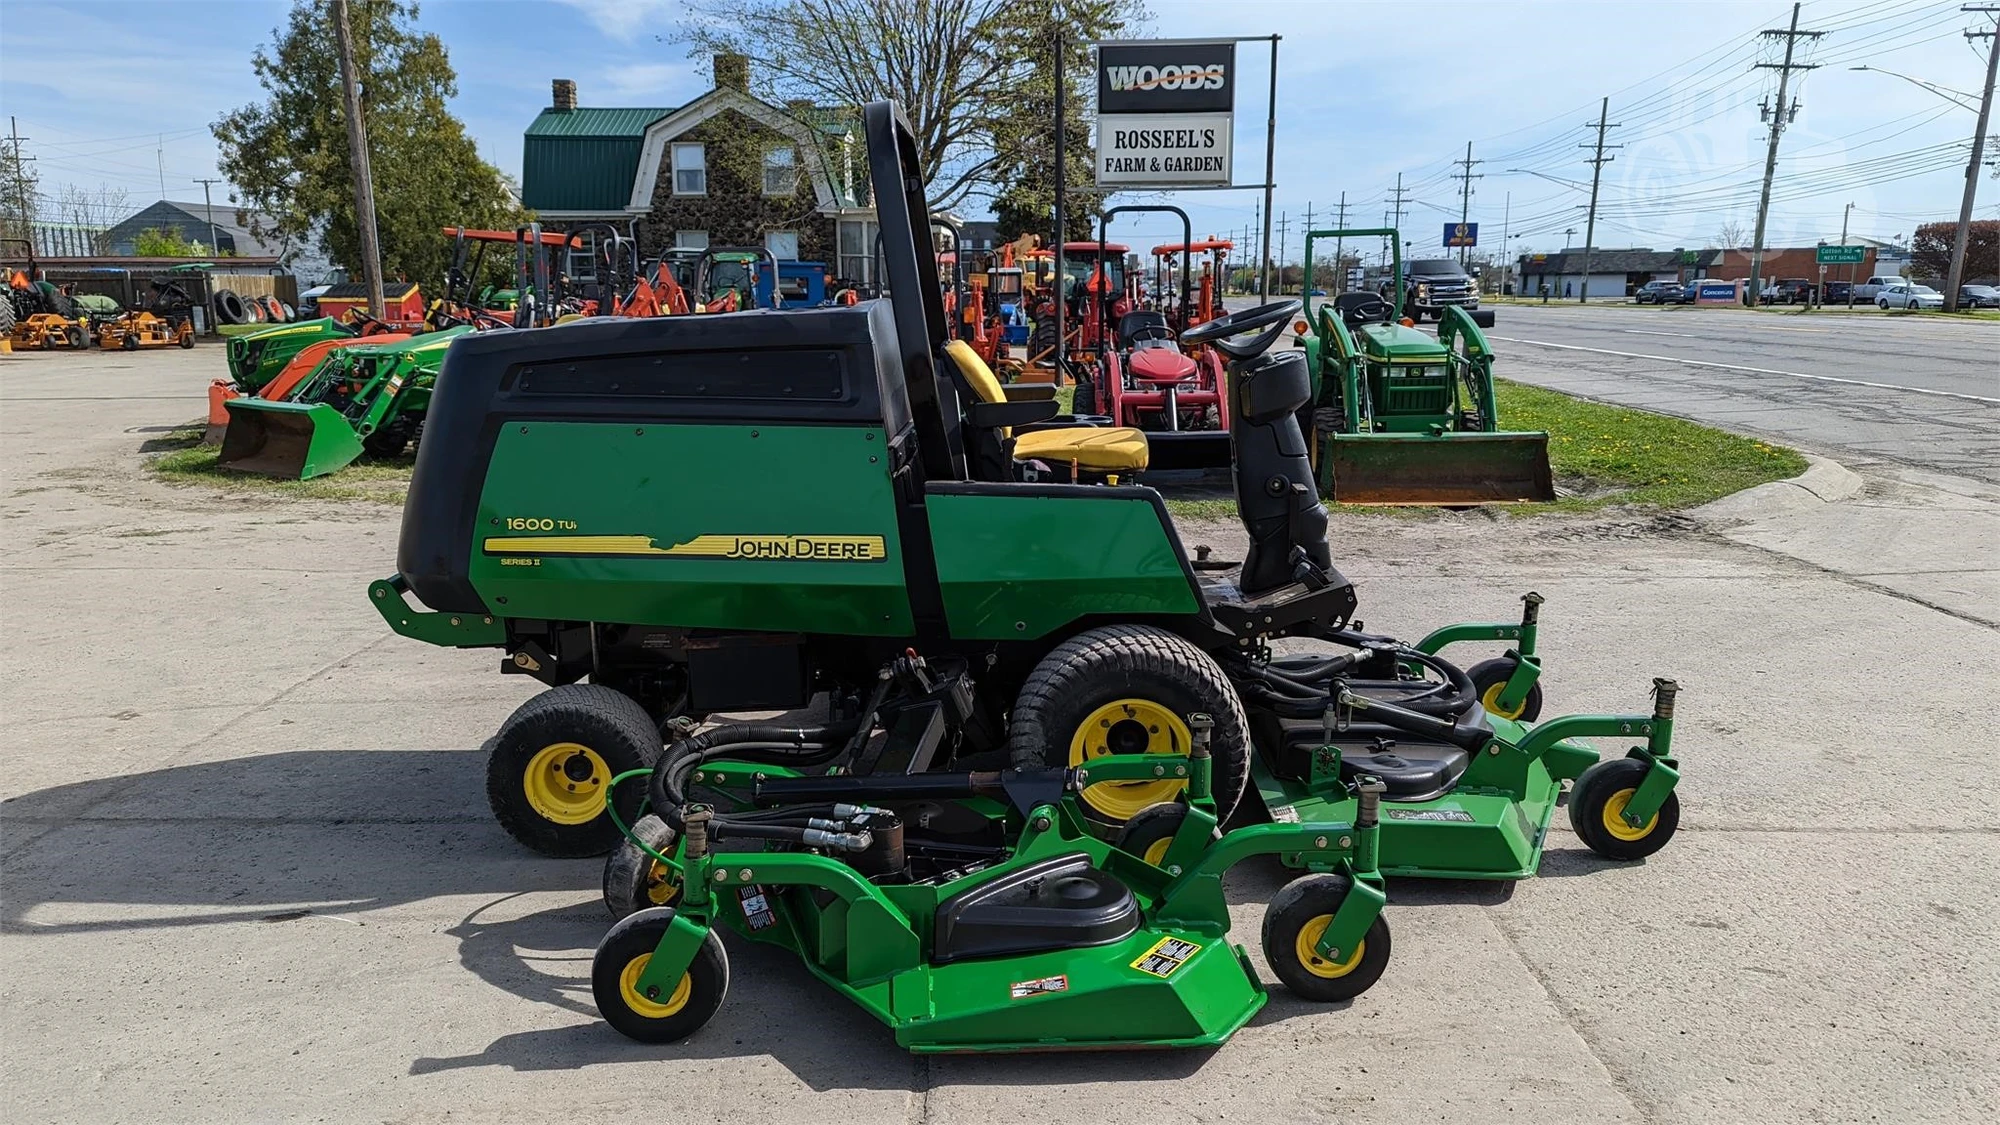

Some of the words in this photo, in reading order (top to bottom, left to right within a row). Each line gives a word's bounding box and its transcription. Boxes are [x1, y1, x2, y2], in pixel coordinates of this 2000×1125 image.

[1107, 64, 1225, 91] WOODS
[1115, 129, 1215, 149] ROSSEEL'S
[1105, 157, 1146, 173] FARM
[1150, 157, 1161, 172] &
[1164, 156, 1224, 172] GARDEN
[506, 518, 554, 531] 1600
[727, 538, 790, 557] JOHN
[796, 538, 871, 558] DEERE
[500, 558, 533, 566] SERIES
[534, 558, 541, 566] II
